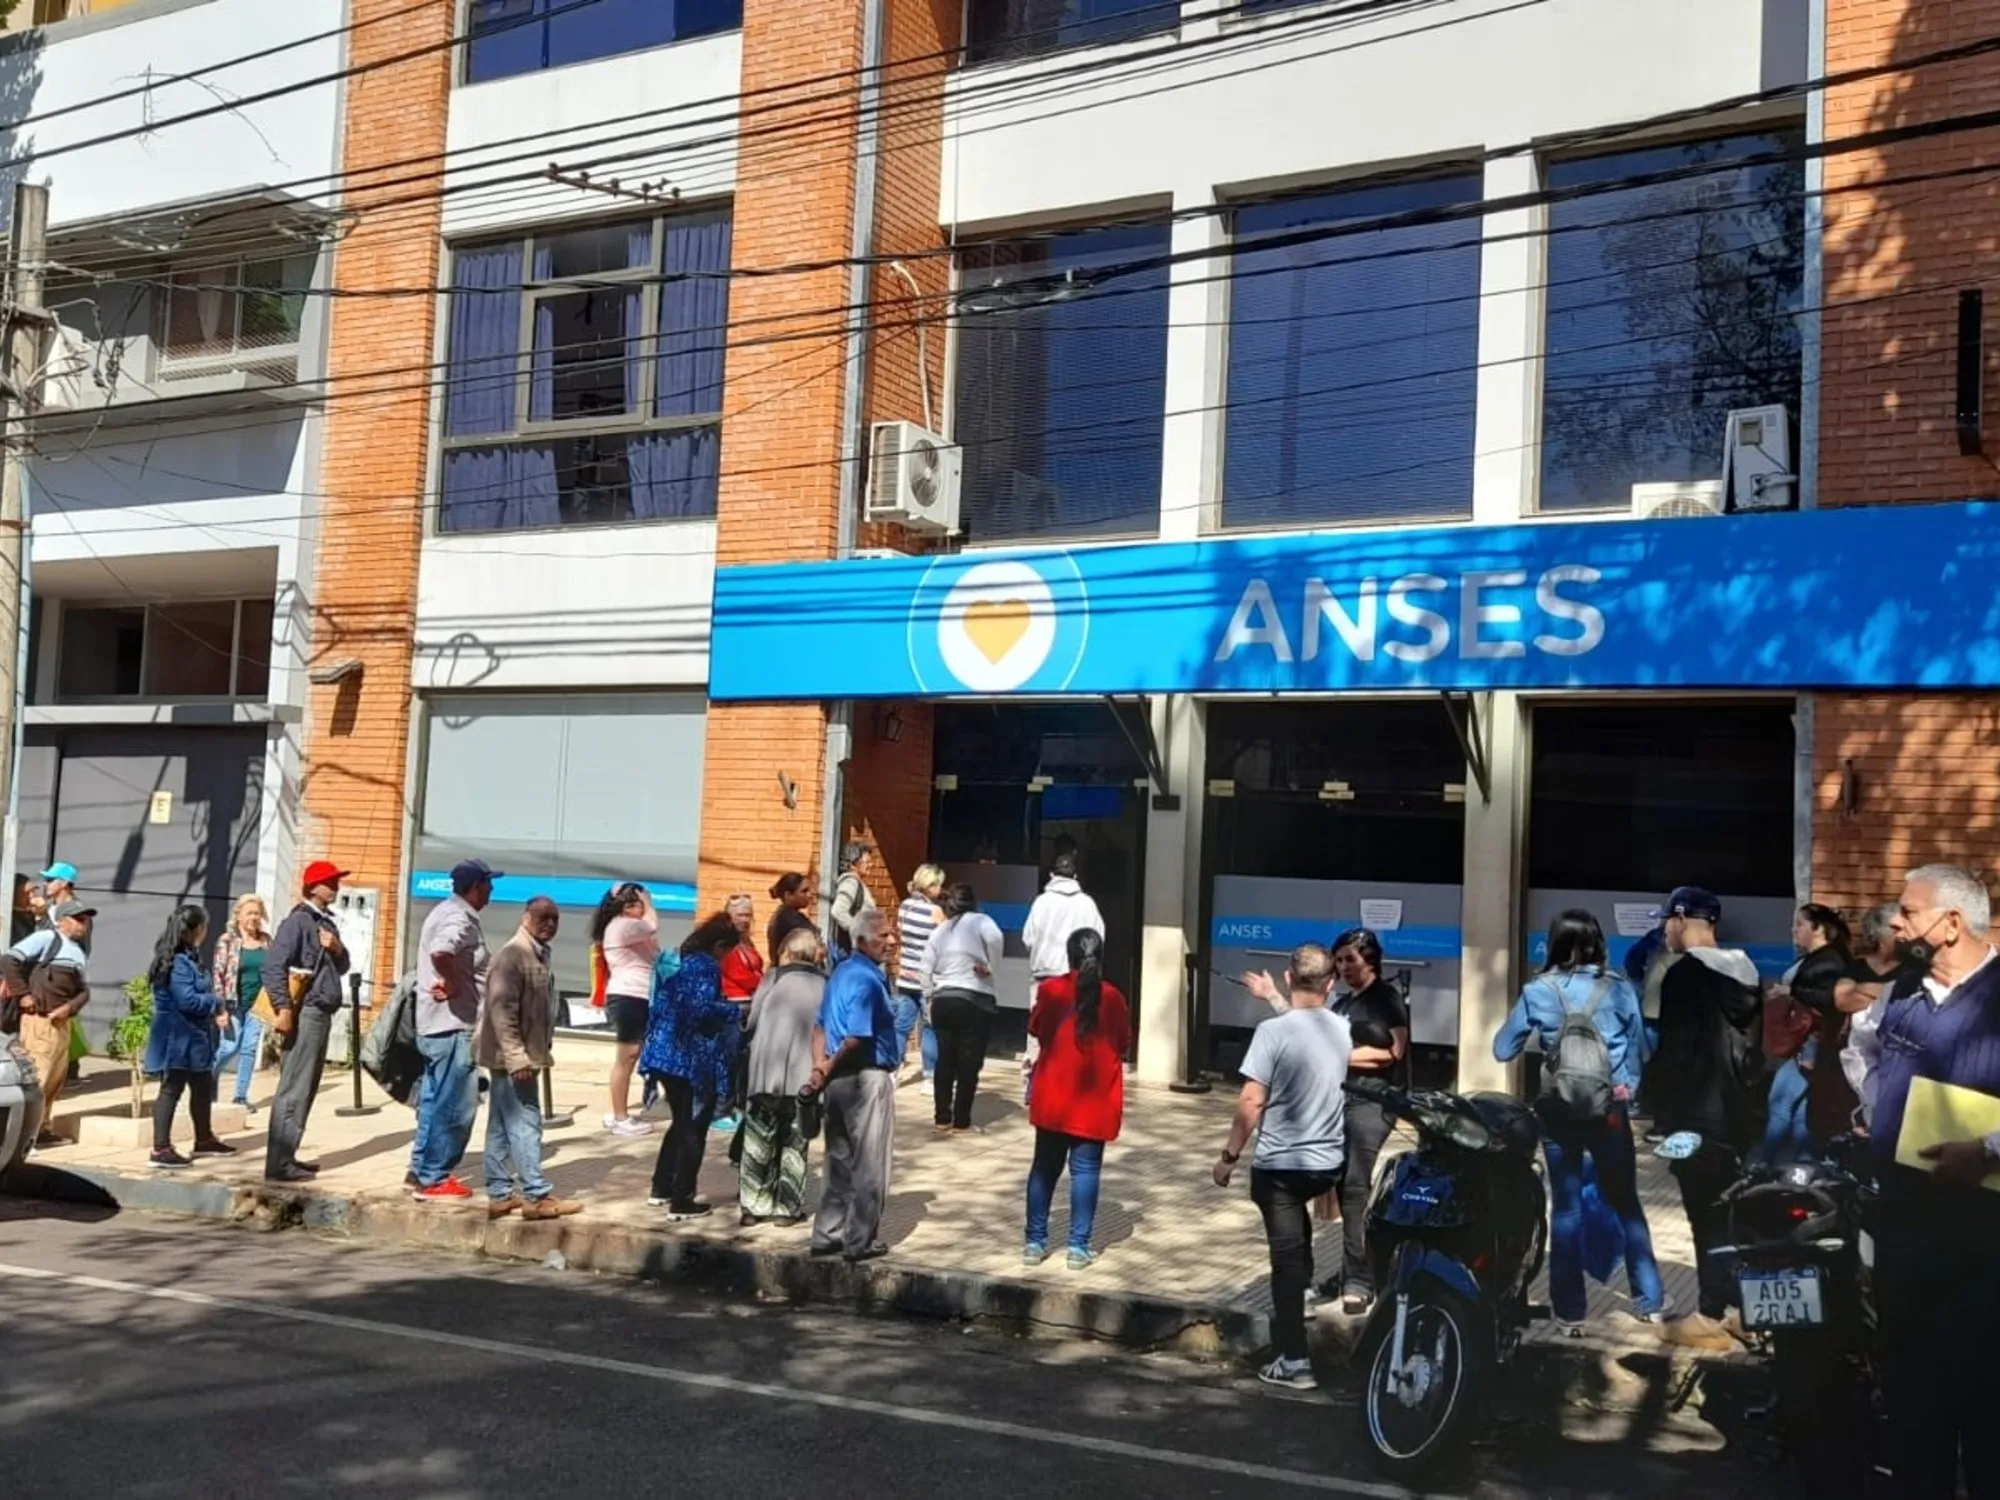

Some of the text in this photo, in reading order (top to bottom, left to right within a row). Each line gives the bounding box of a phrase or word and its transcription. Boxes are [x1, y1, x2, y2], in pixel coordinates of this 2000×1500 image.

[1214, 564, 1605, 662] ANSES
[1218, 922, 1272, 939] ANSES
[1760, 1280, 1801, 1301] A05
